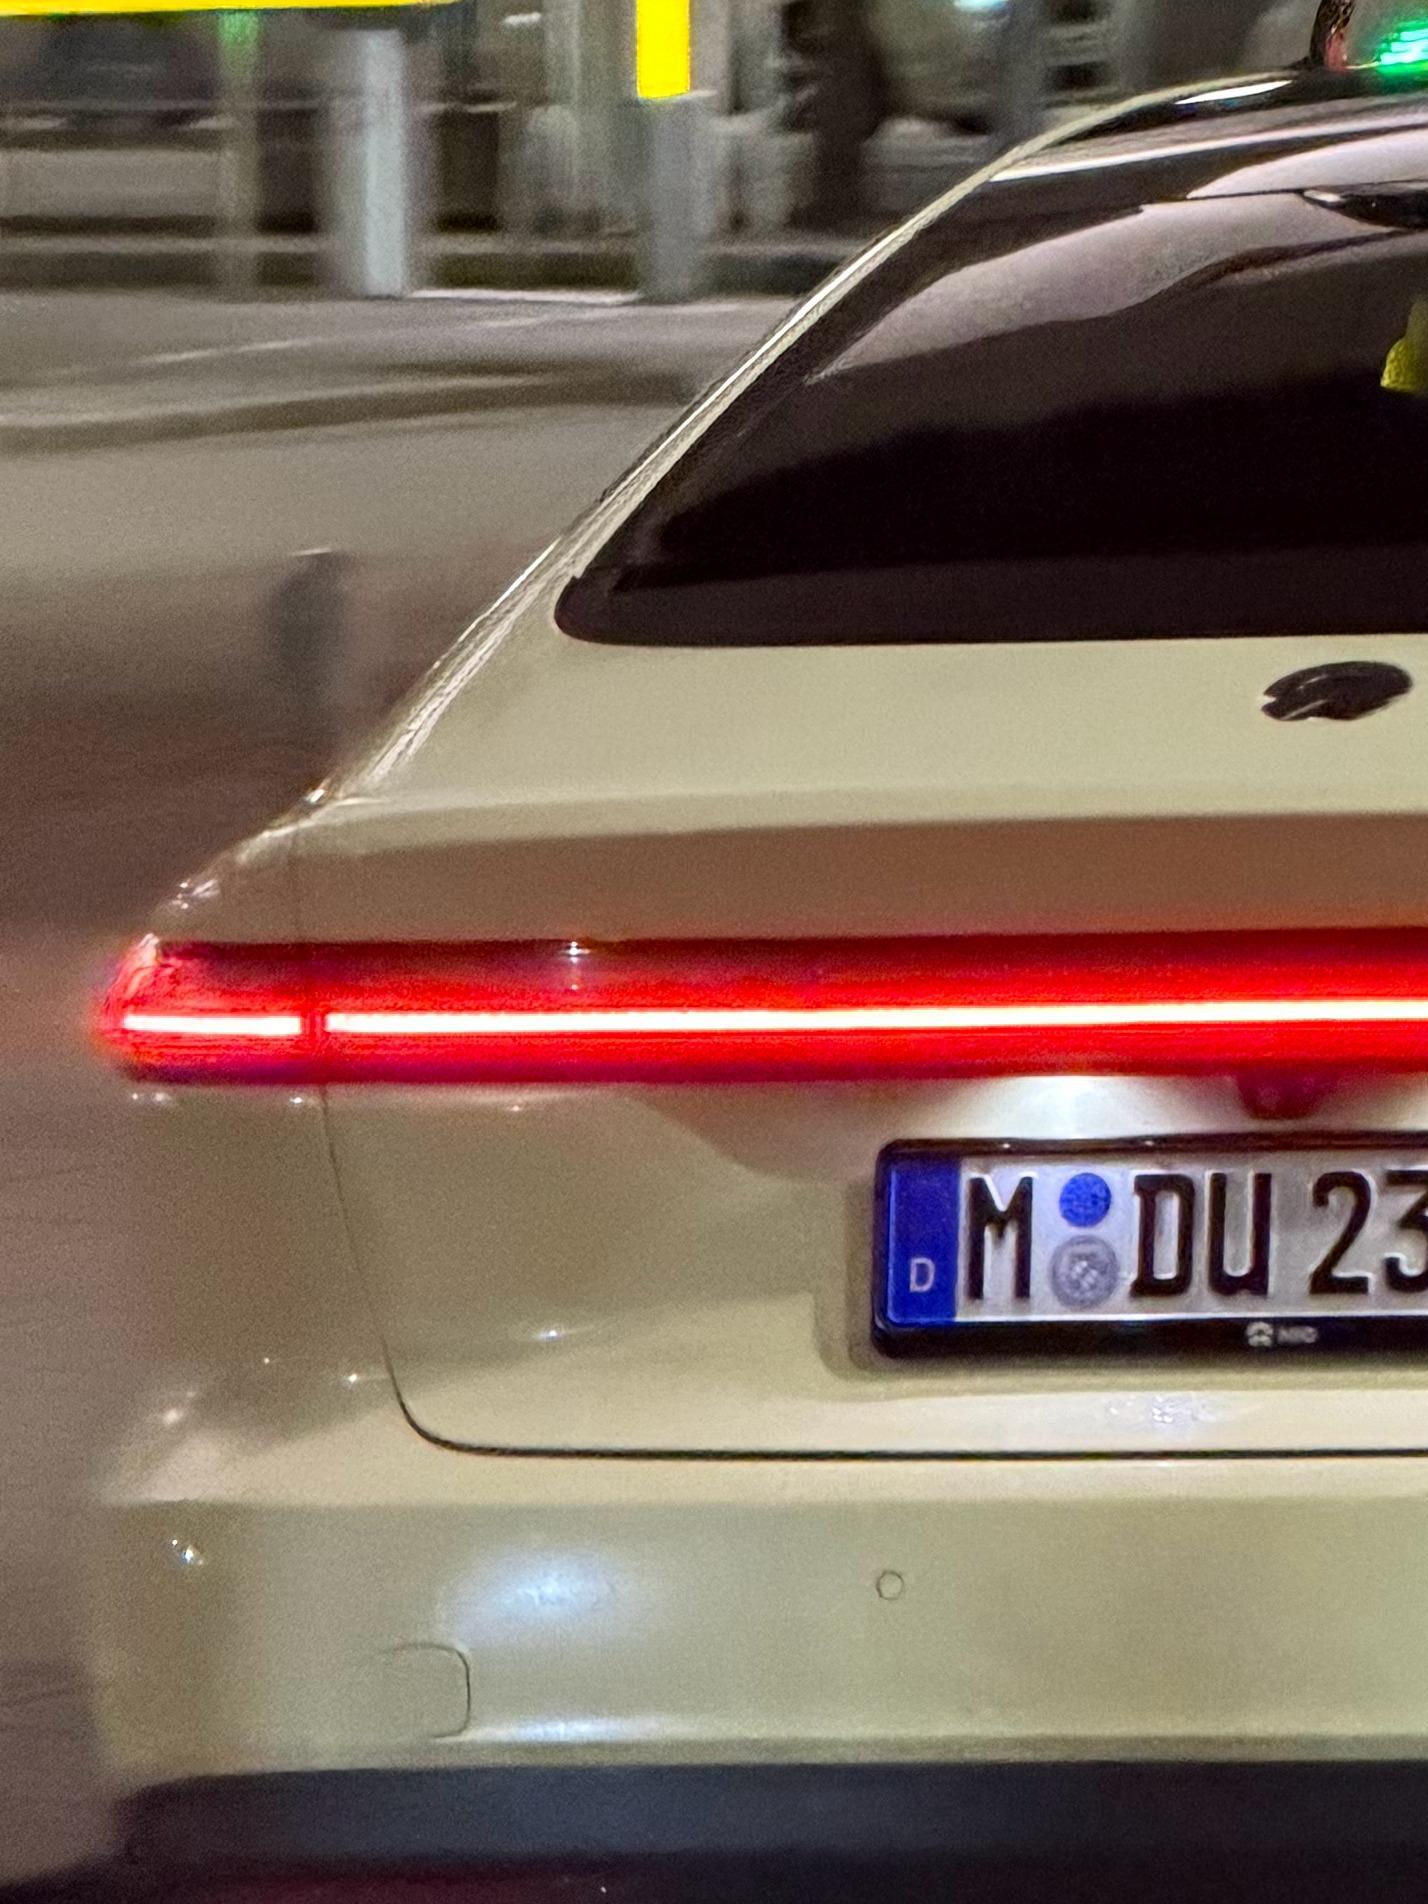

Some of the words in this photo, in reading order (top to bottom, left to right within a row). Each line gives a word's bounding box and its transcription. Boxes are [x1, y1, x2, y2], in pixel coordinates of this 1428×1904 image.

[909, 1257, 935, 1293] D
[968, 1175, 1033, 1300] M
[1130, 1172, 1272, 1297] DU
